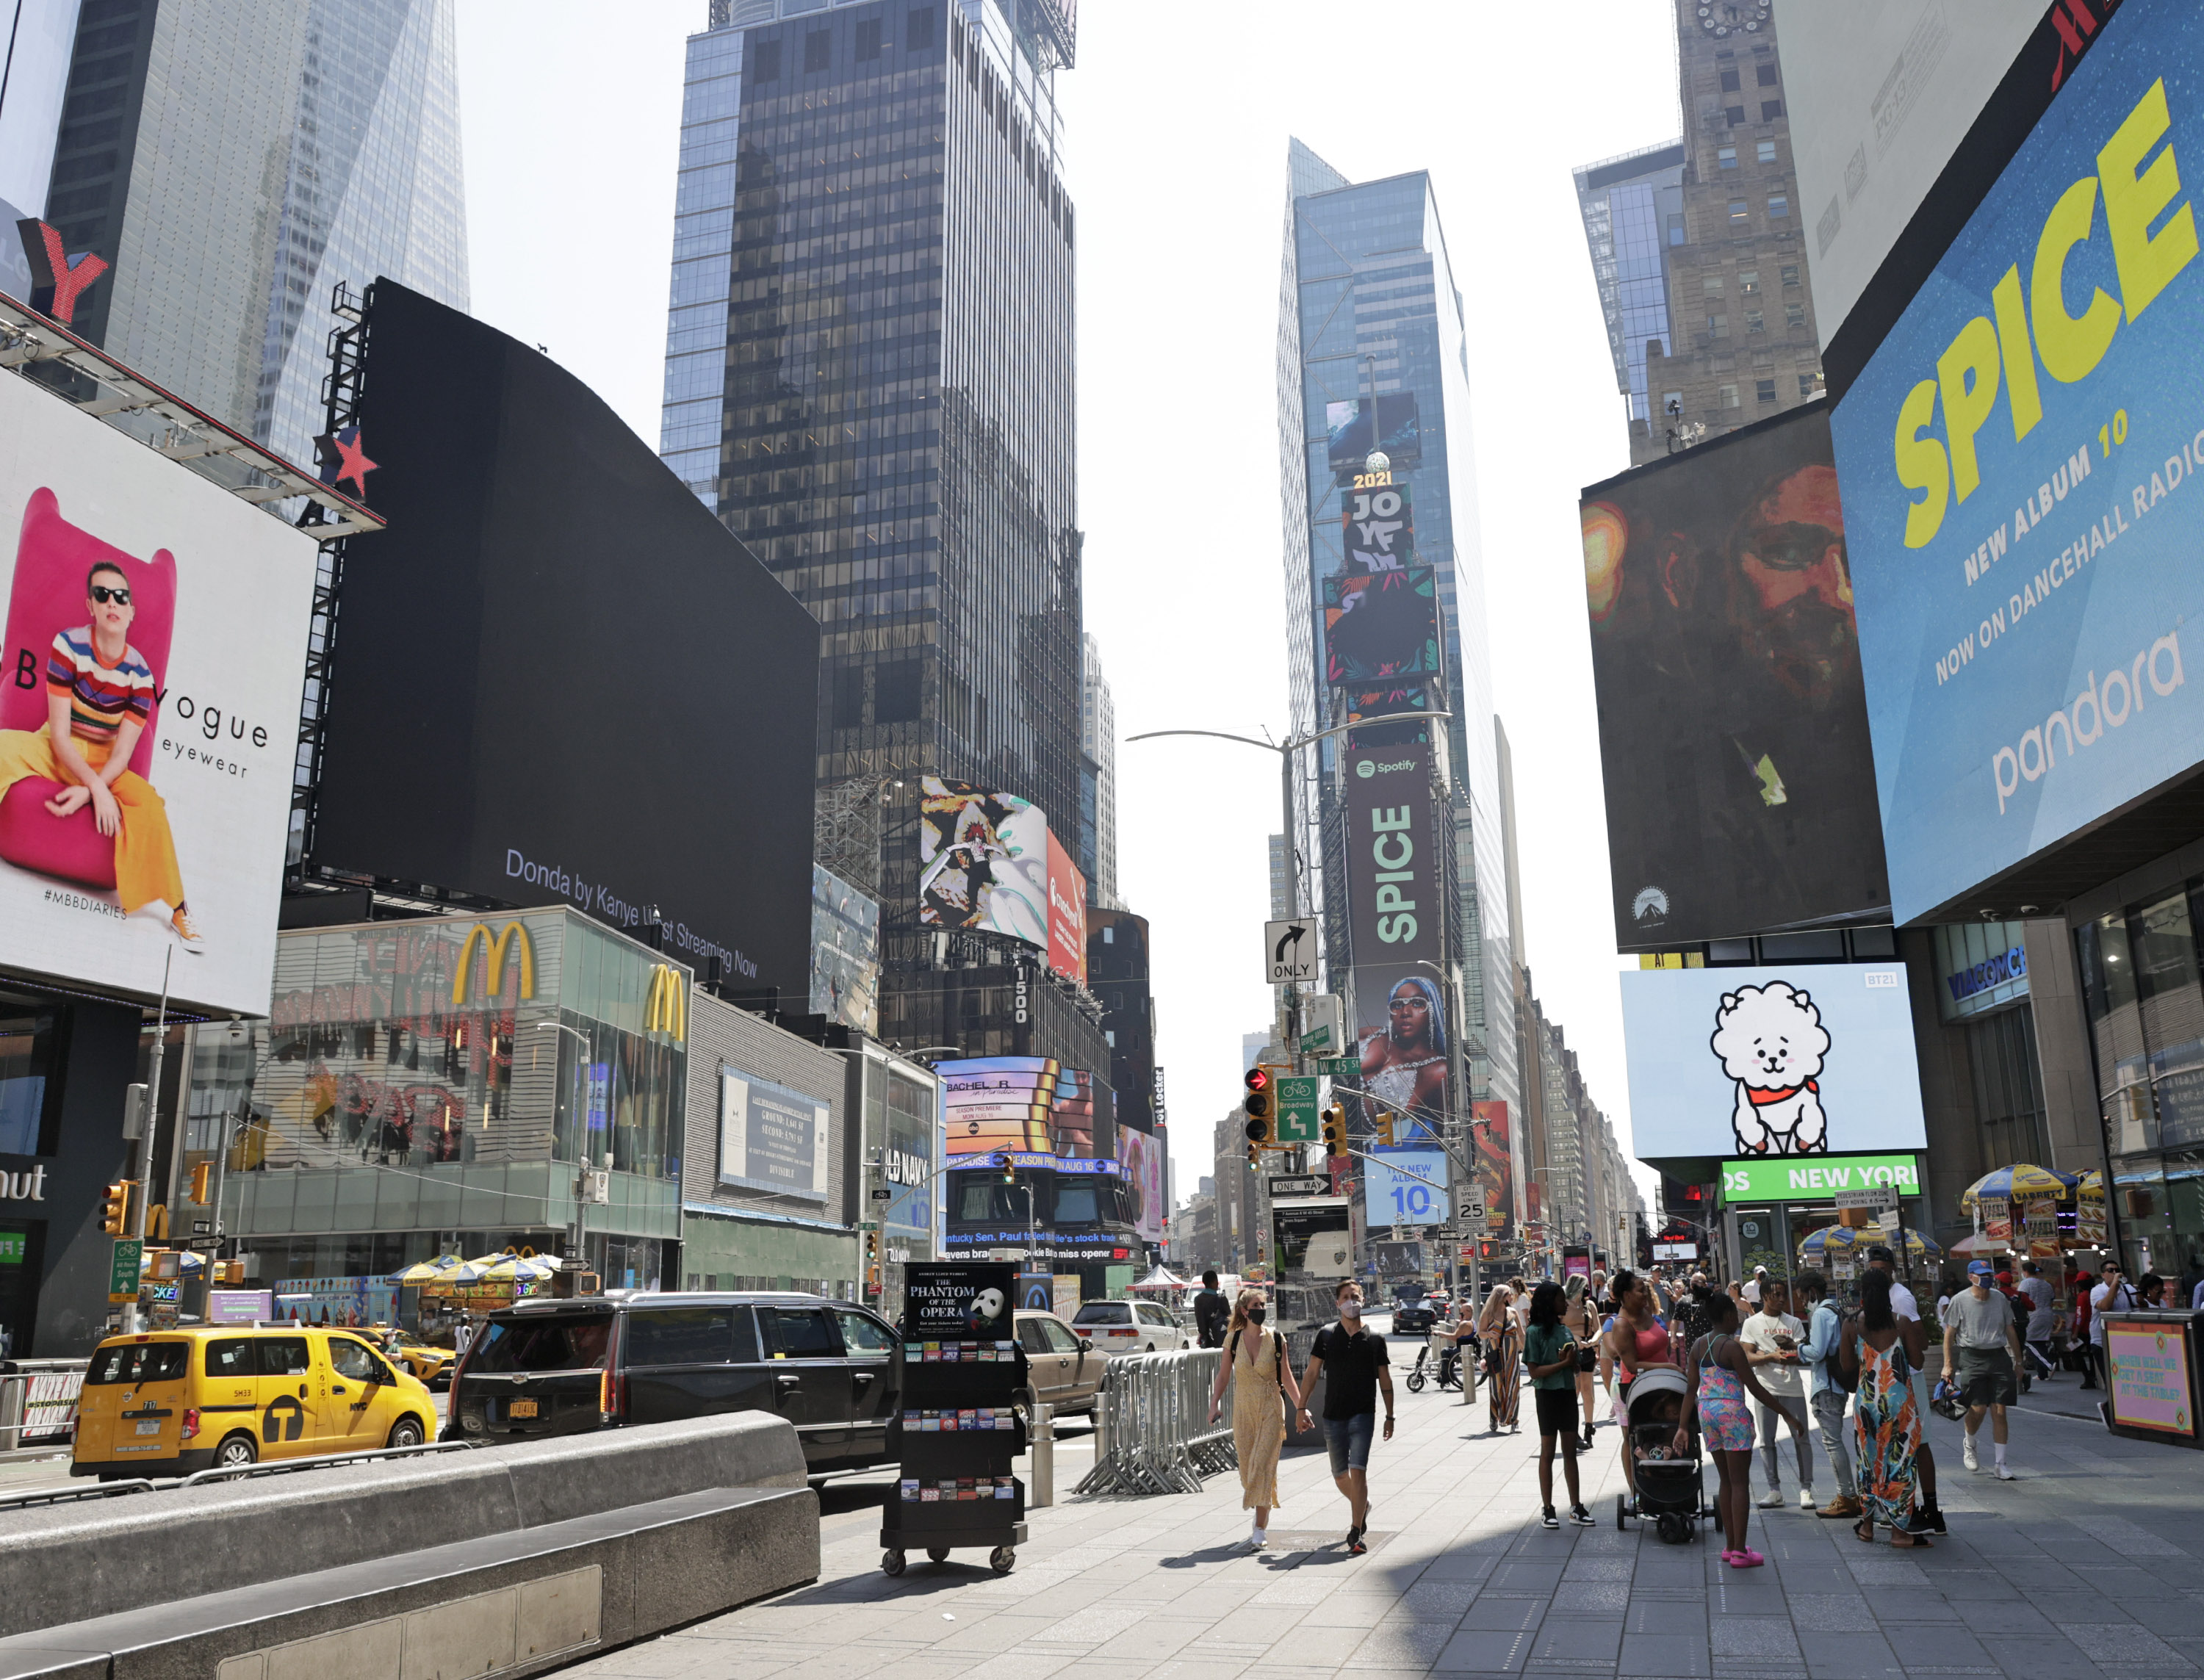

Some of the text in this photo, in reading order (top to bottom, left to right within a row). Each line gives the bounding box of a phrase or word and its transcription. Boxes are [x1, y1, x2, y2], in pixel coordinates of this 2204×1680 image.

[1895, 76, 2200, 549] SPICE
[1353, 471, 1392, 489] 2021
[1964, 409, 2128, 587] NEW ALBUM 10
[1935, 506, 2129, 686] NOW ON DANCEHALL
[151, 683, 268, 748] vogue
[1992, 630, 2185, 815] pandora
[162, 738, 248, 779] eyewear
[1378, 760, 1416, 774] Spotify
[1372, 804, 1418, 944] SPICE
[44, 889, 128, 920] #MBBDIARIES
[506, 848, 757, 978] Donda by Kanye Streaming Now
[1275, 964, 1310, 978] ONLY
[1868, 974, 1895, 986] BT21
[1015, 967, 1027, 1023] 1500
[1319, 1059, 1359, 1073] W 45 St
[1154, 1070, 1164, 1106] Locker
[761, 1110, 804, 1131] GROUND: SF
[761, 1124, 784, 1139] SECOND:
[797, 1134, 803, 1145] SF
[946, 1156, 990, 1167] PARADISE
[1065, 1161, 1082, 1171] AUG
[1084, 1162, 1094, 1171] 16
[1408, 1164, 1432, 1173] NEW
[769, 1164, 795, 1178] DIVISIBLE
[901, 1153, 928, 1189] NAVY
[1788, 1167, 1851, 1189] NEW
[1277, 1180, 1322, 1191] ONE WAY
[1390, 1185, 1430, 1216] 10
[2014, 1189, 2064, 1201] SABRETT
[1460, 1204, 1483, 1218] 25
[976, 1233, 997, 1241] Sen.
[999, 1232, 1022, 1241] Paul
[1075, 1233, 1116, 1242] stock trade
[887, 1248, 910, 1263] OLD NAVY
[1059, 1250, 1079, 1258] miss
[1081, 1250, 1110, 1260] opener
[117, 1270, 134, 1278] South
[910, 1286, 975, 1297] PHANTOM
[921, 1307, 964, 1318] OPERA
[2118, 1355, 2177, 1371] WHEN WILL WE
[2120, 1369, 2164, 1385] GET A SEAT
[2122, 1384, 2180, 1402] AT THE TABLE?
[144, 1401, 156, 1409] 717
[349, 1402, 367, 1412] NYC
